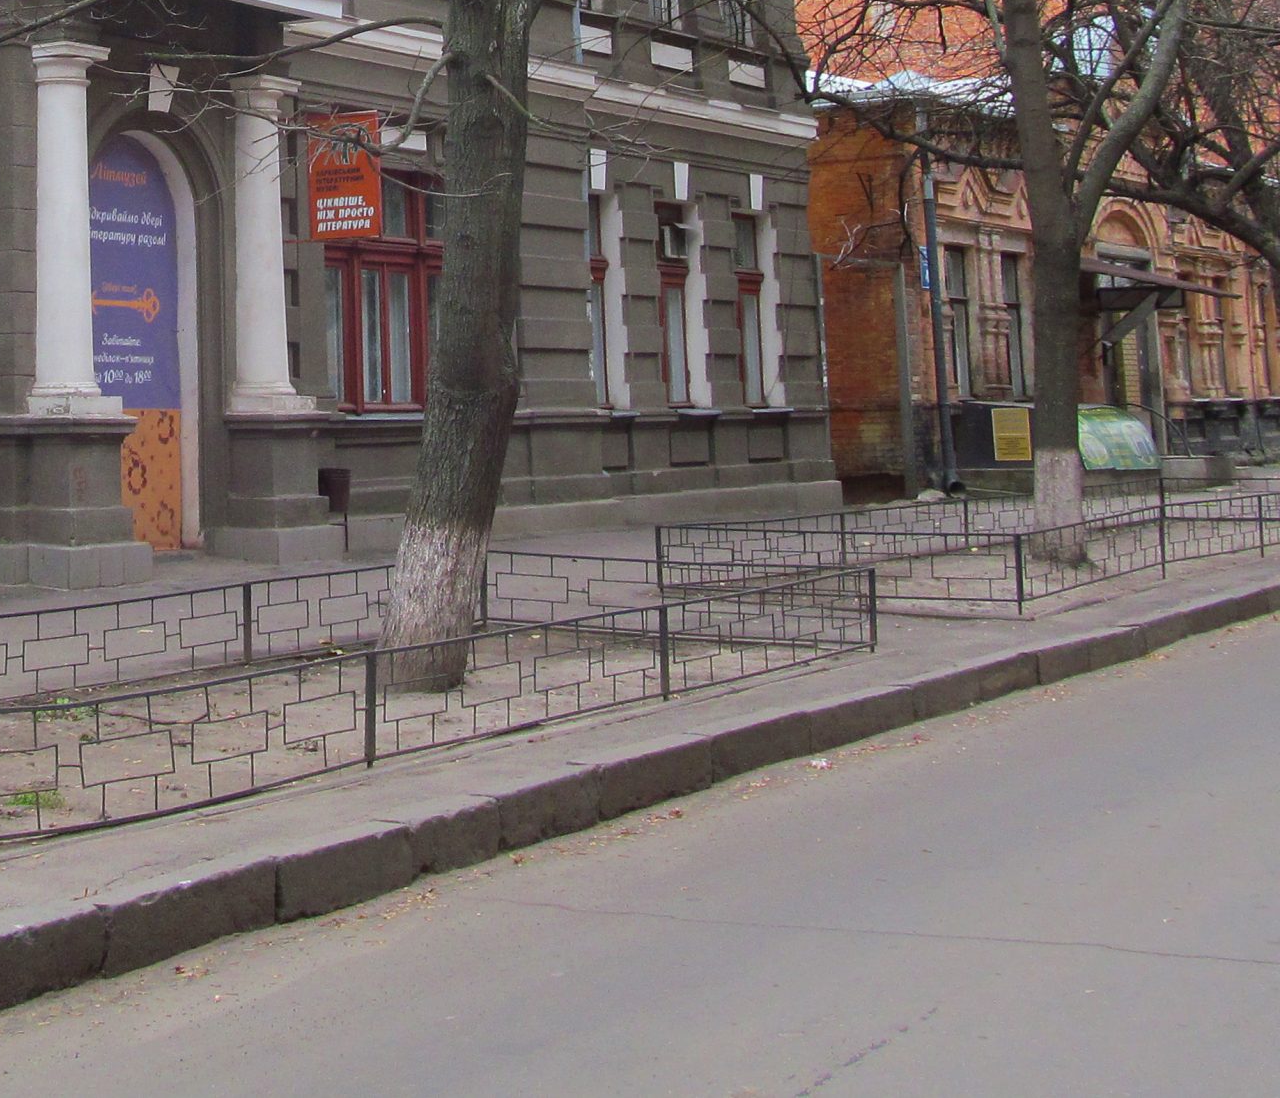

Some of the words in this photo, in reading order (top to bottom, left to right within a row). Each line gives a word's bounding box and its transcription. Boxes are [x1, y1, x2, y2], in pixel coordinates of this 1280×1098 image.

[91, 162, 147, 188] Літмузей
[316, 195, 366, 210] ЦІКАВІШЕ,
[90, 206, 139, 223] дкриваймо
[141, 211, 163, 228] двері
[317, 209, 336, 220] НІЖ
[338, 206, 375, 219] ПРОСТО
[317, 218, 371, 233] ЛІТЕРАТУРА
[90, 228, 136, 245] тературу
